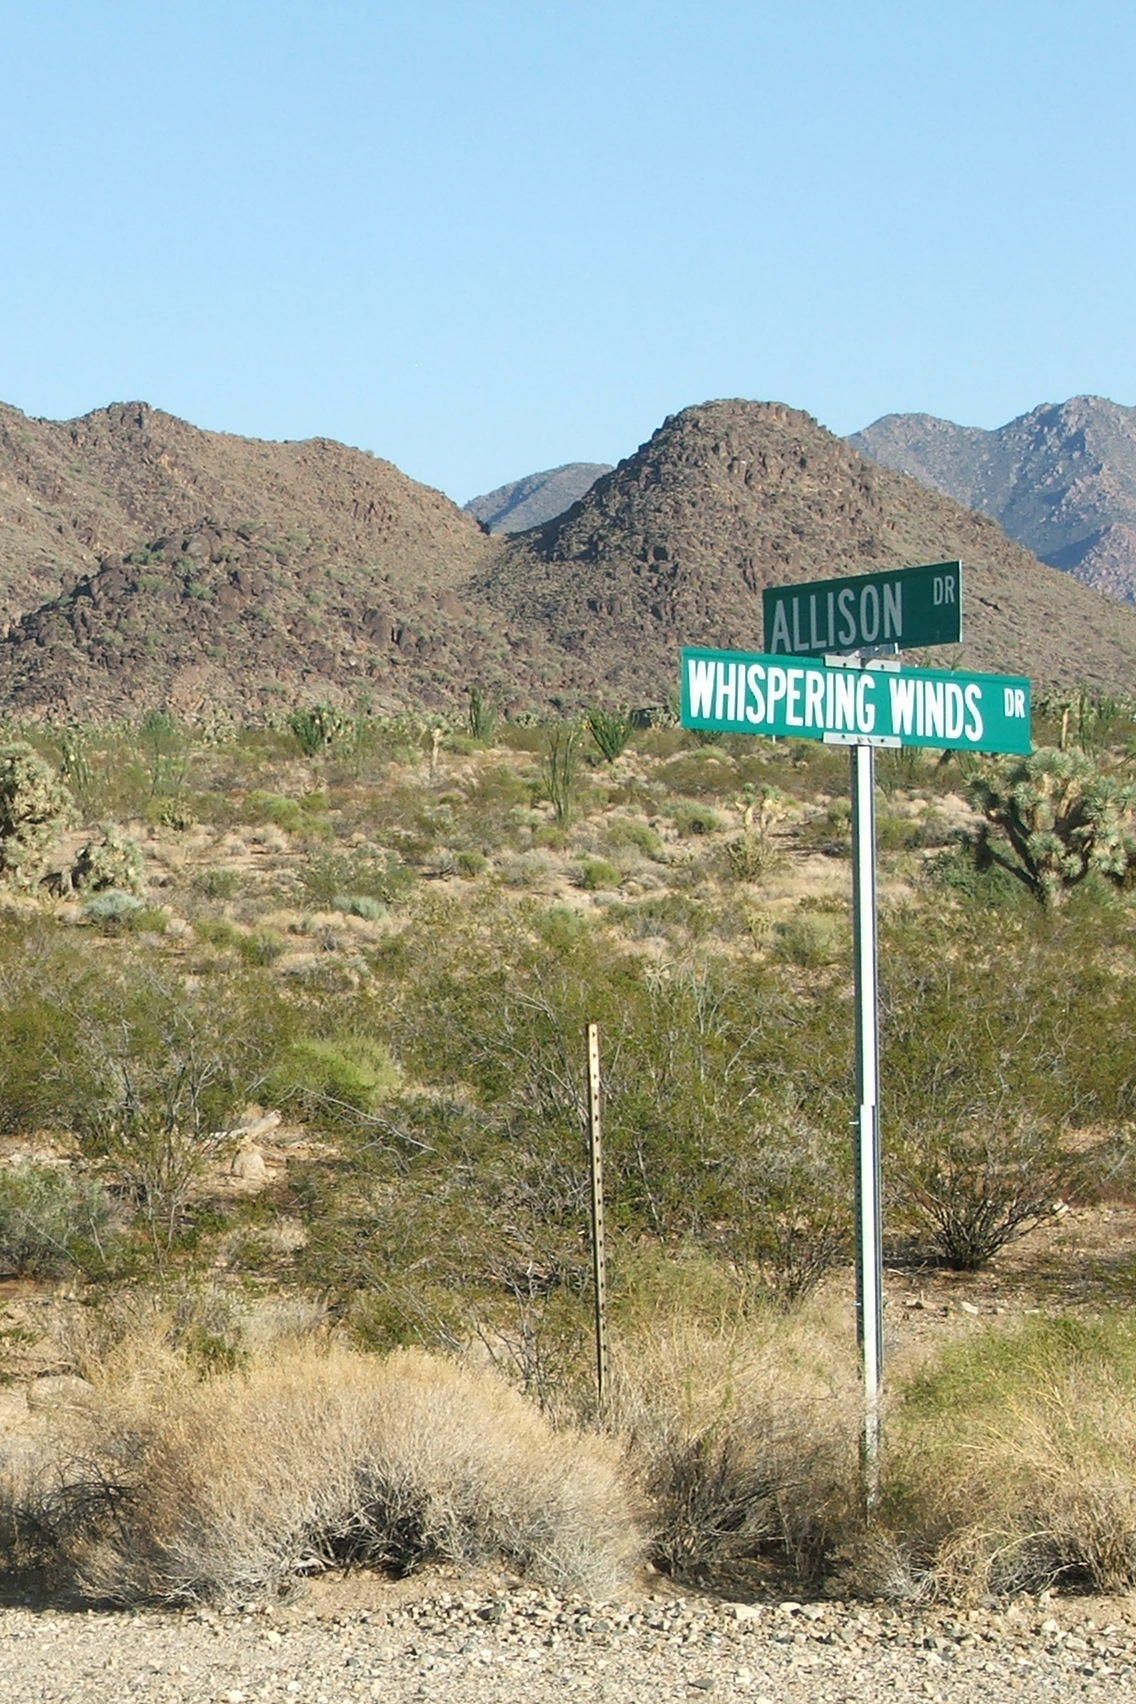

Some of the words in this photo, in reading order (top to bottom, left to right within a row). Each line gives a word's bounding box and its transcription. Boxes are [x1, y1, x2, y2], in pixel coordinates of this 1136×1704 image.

[770, 581, 903, 654] ALLISON
[933, 575, 955, 606] DR
[688, 660, 876, 733] WHISPERING
[889, 678, 984, 742] WINDS
[1003, 688, 1026, 719] DR
